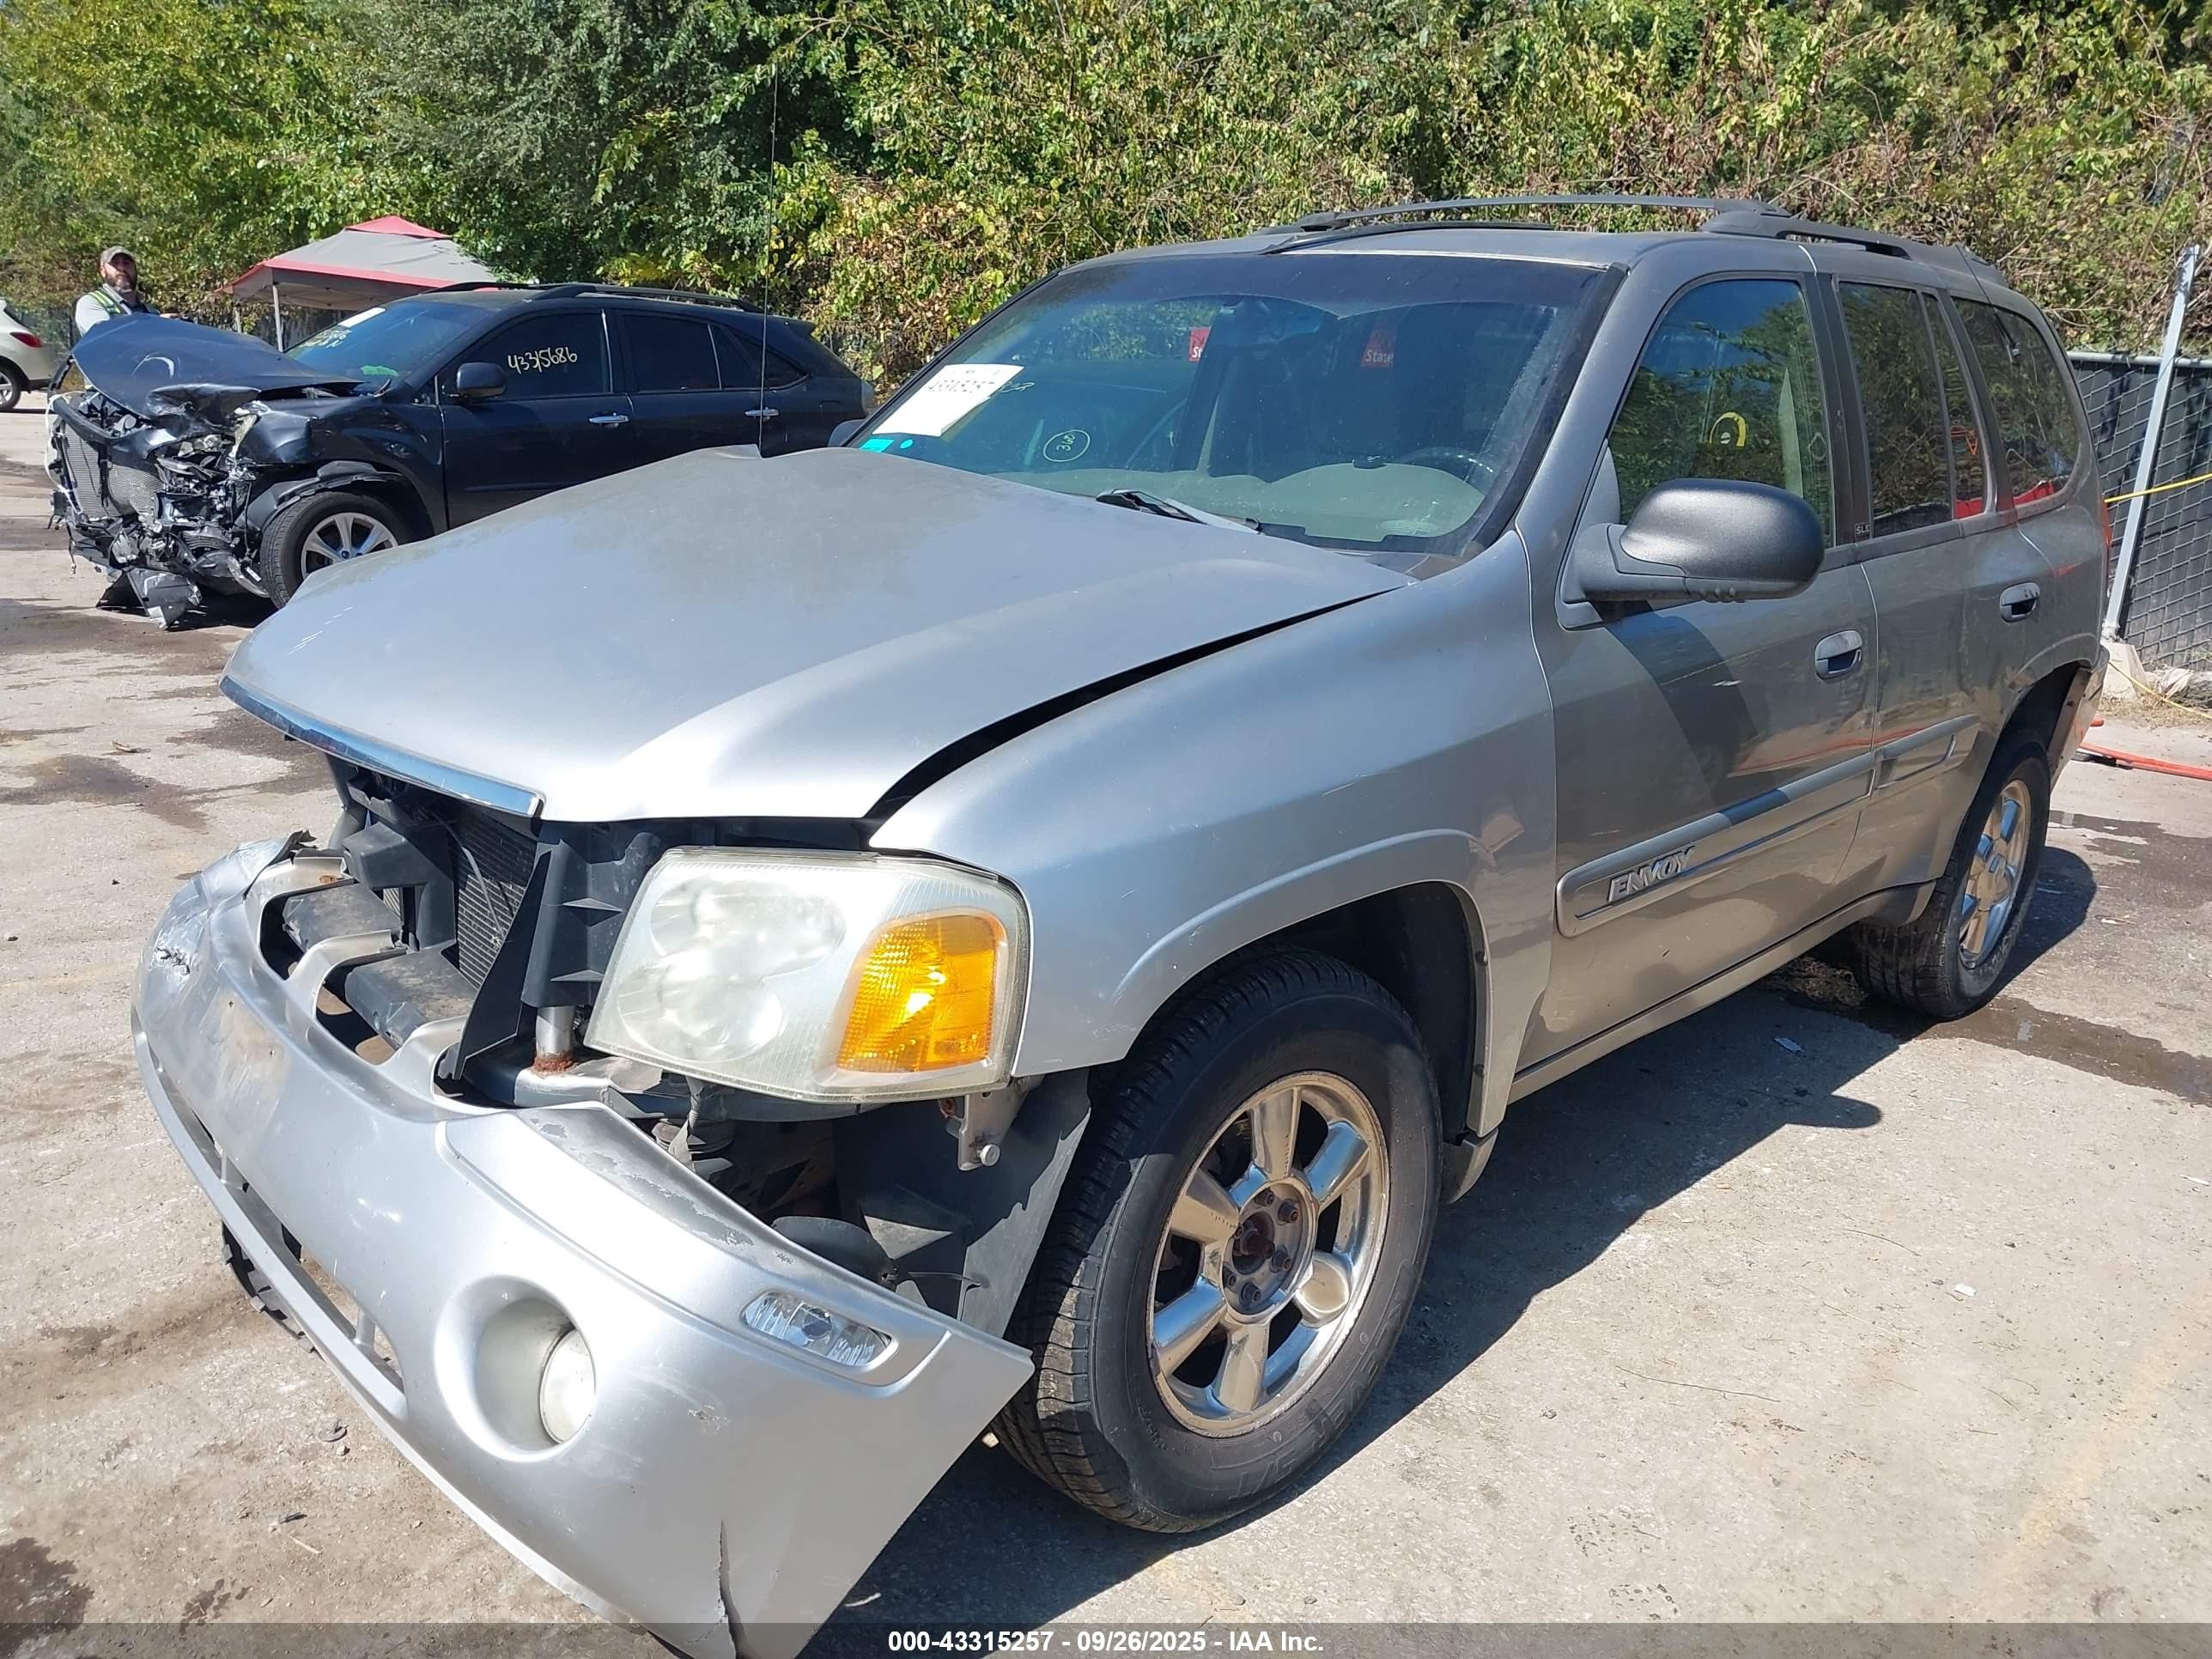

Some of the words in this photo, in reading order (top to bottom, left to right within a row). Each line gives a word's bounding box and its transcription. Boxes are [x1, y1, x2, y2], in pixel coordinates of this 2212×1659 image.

[507, 346, 578, 374] 43315686
[1856, 524, 1870, 535] SLE
[1607, 845, 1695, 902] ENVOY
